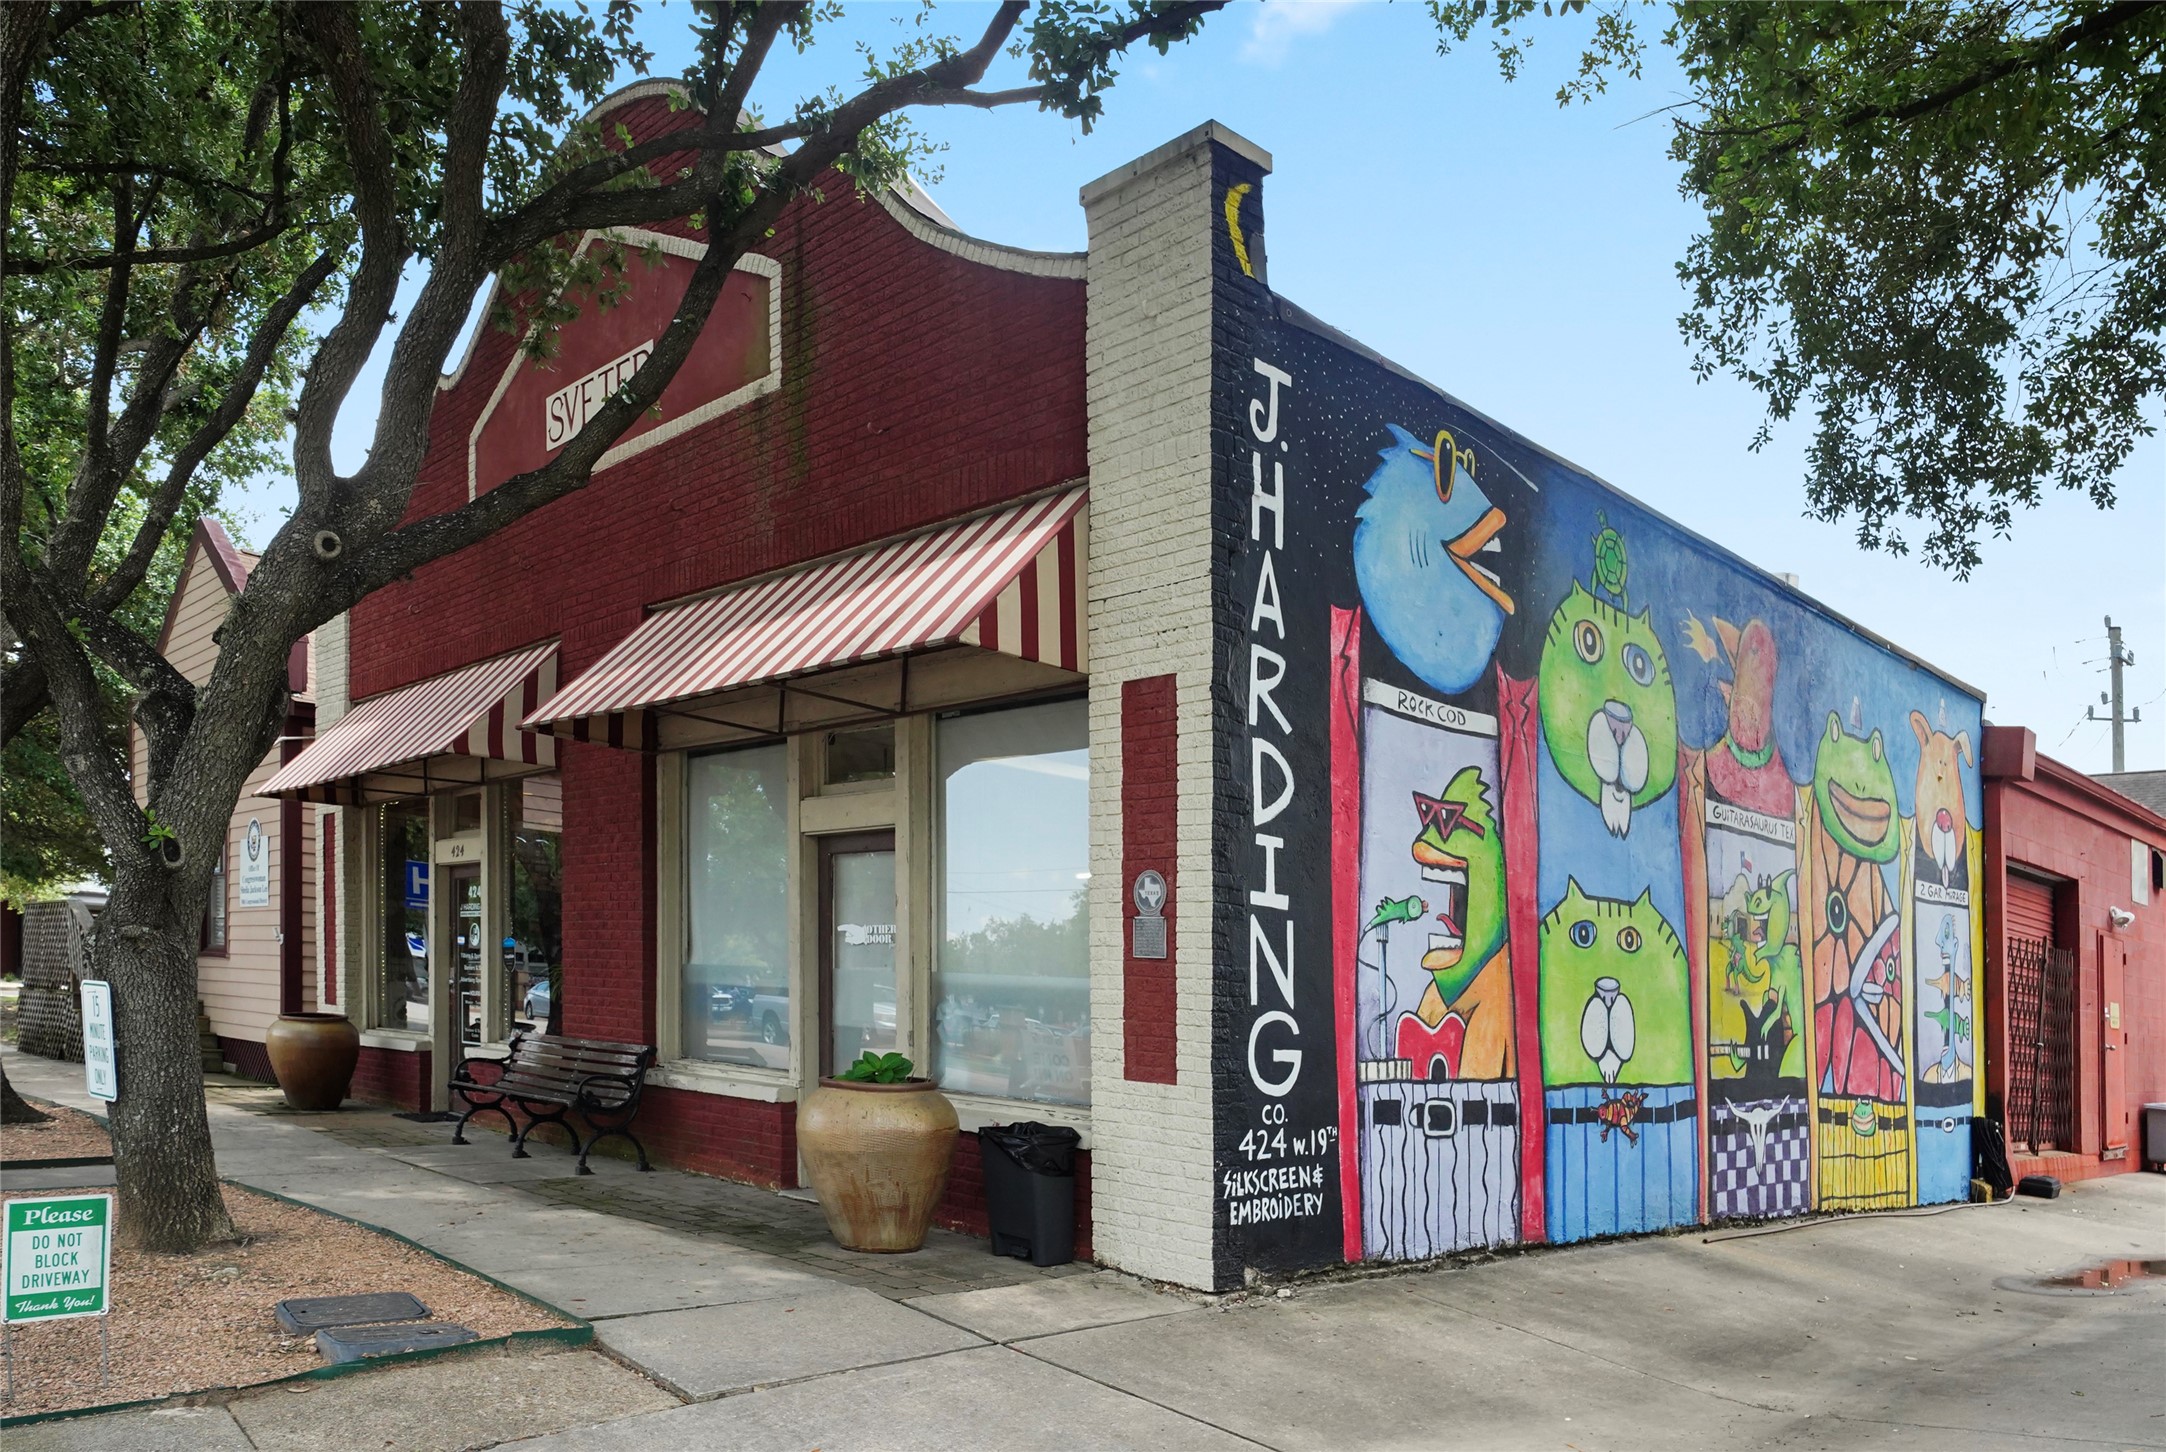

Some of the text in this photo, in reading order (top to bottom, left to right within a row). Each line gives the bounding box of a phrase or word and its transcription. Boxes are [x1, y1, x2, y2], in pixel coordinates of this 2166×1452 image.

[1397, 690, 1467, 726] ROCK COD
[1247, 451, 1303, 1097] HARDING
[1779, 823, 1795, 840] TEX
[451, 844, 465, 858] 424
[468, 885, 481, 898] 424
[1920, 883, 1926, 896] 2
[1927, 885, 1943, 899] GAR
[866, 924, 897, 934] OTHER
[92, 994, 101, 1018] 15
[89, 1022, 107, 1041] MINUTE
[89, 1044, 110, 1064] PARKING
[94, 1067, 107, 1086] ONLY
[1261, 1103, 1289, 1125] CO.
[1238, 1127, 1288, 1161] 424
[22, 1206, 95, 1226] Please
[32, 1232, 83, 1250] DO NOT
[35, 1251, 79, 1269] BLOCK
[21, 1268, 90, 1289] DRIVEWAY
[15, 1295, 95, 1313] Thank You!
